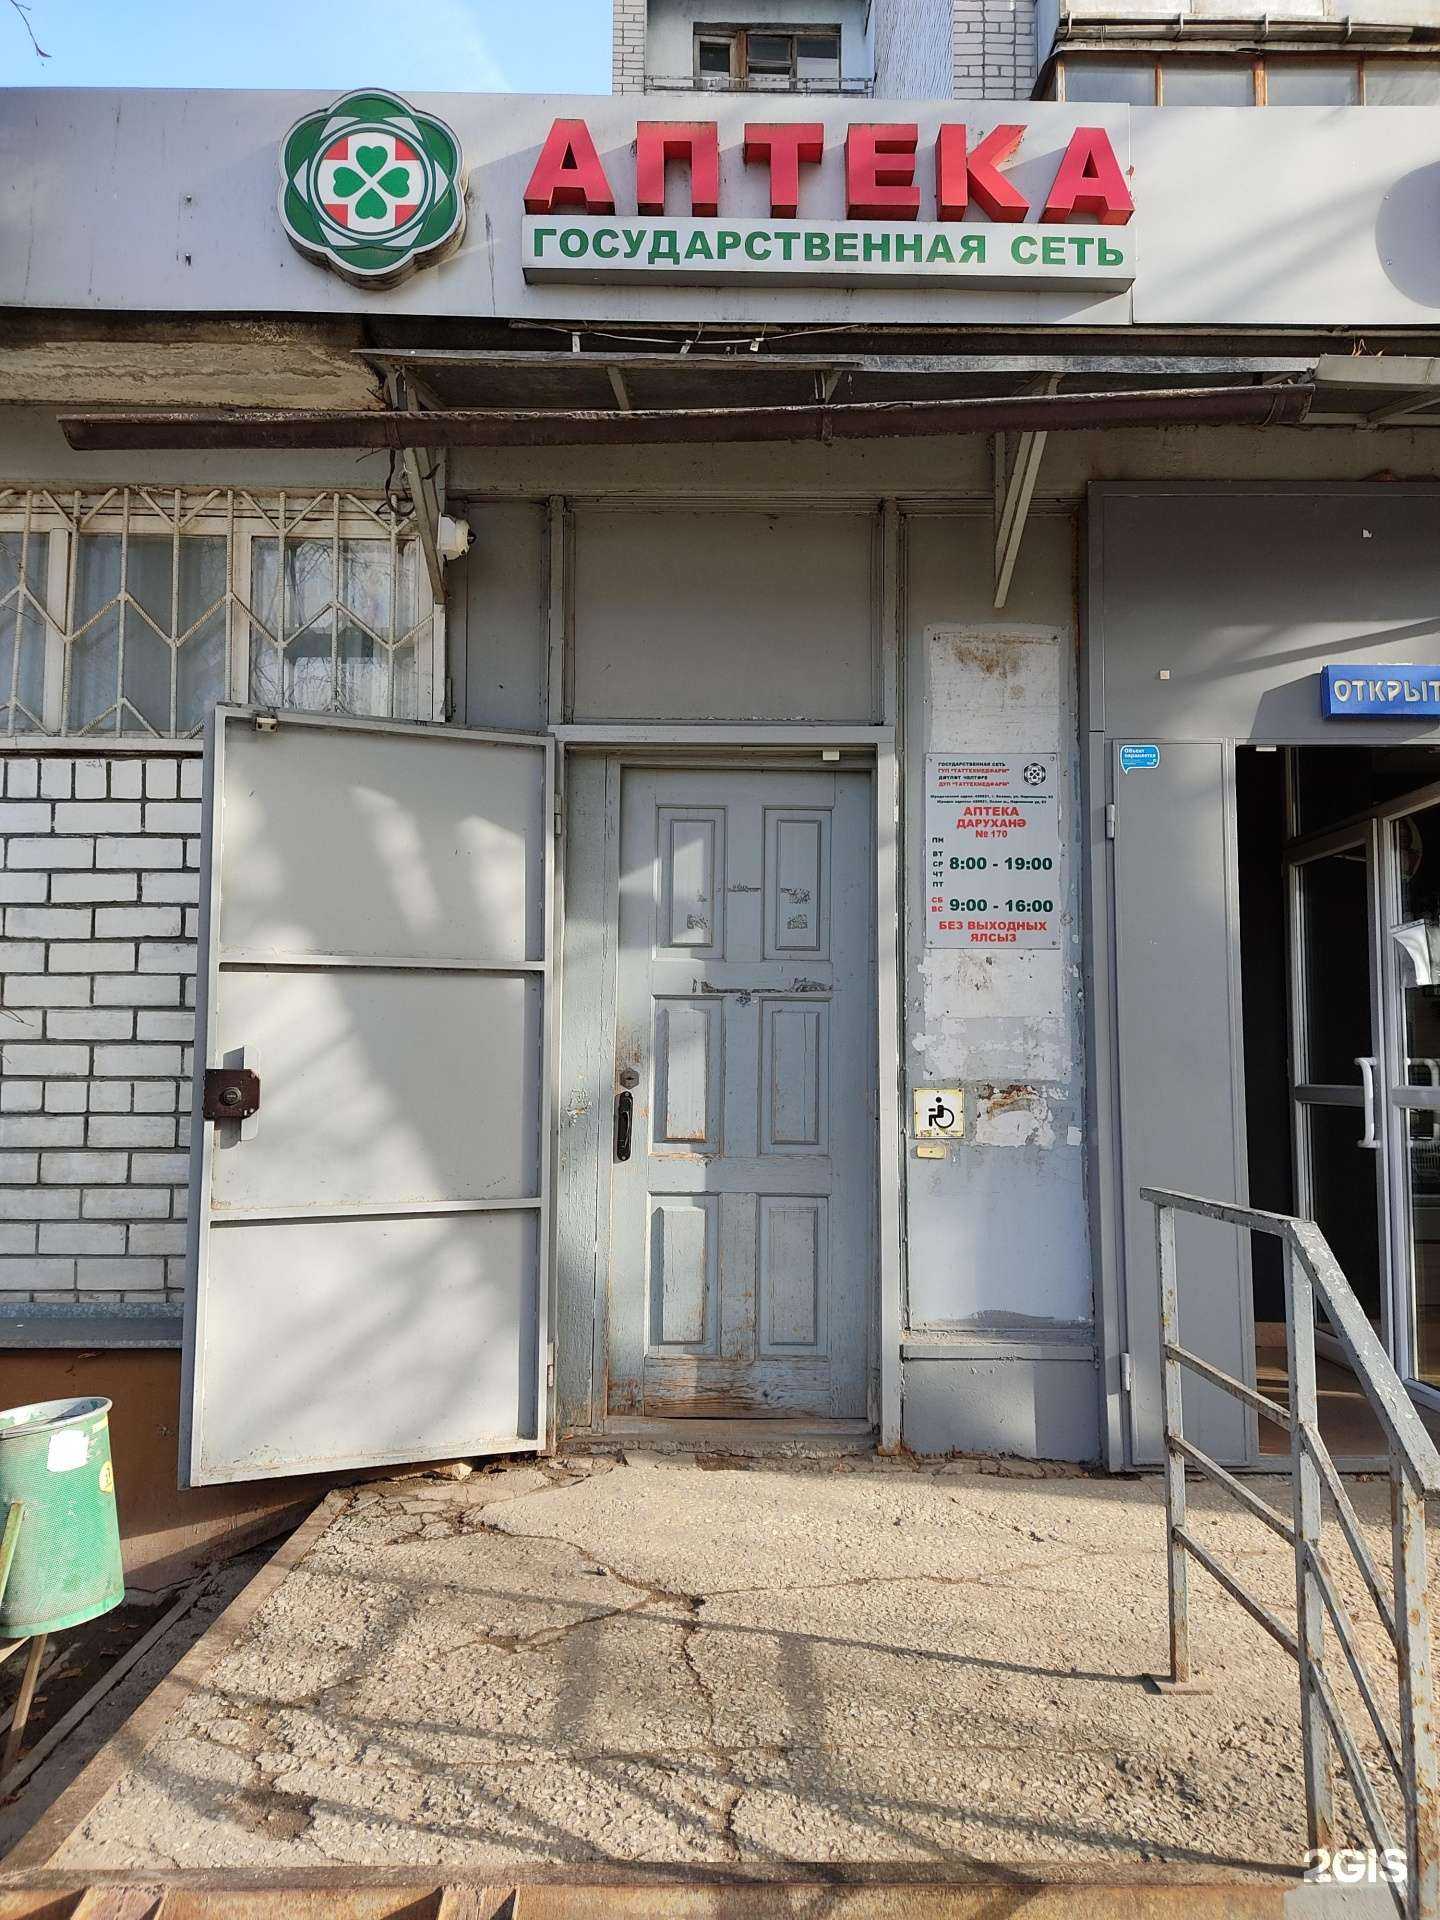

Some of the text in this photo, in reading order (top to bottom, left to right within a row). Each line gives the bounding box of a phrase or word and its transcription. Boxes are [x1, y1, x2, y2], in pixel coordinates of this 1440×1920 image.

[523, 117, 1135, 225] АПТЕКА
[533, 227, 1125, 267] ГОСУДАРСТВЕННАЯ СЕТЬ
[963, 806, 1020, 817] АПТЕКА
[956, 818, 1027, 829] ДАРУХАНӘ
[975, 830, 1008, 838] № 170
[949, 857, 987, 870] 8:00
[1005, 857, 1053, 870] 19:00
[949, 899, 987, 912] 9:00
[1005, 899, 1053, 912] 16:00
[939, 921, 1047, 932] БЕЗ ВЫХОДНЫХ
[970, 933, 1017, 942] ЯЛСЫЗ
